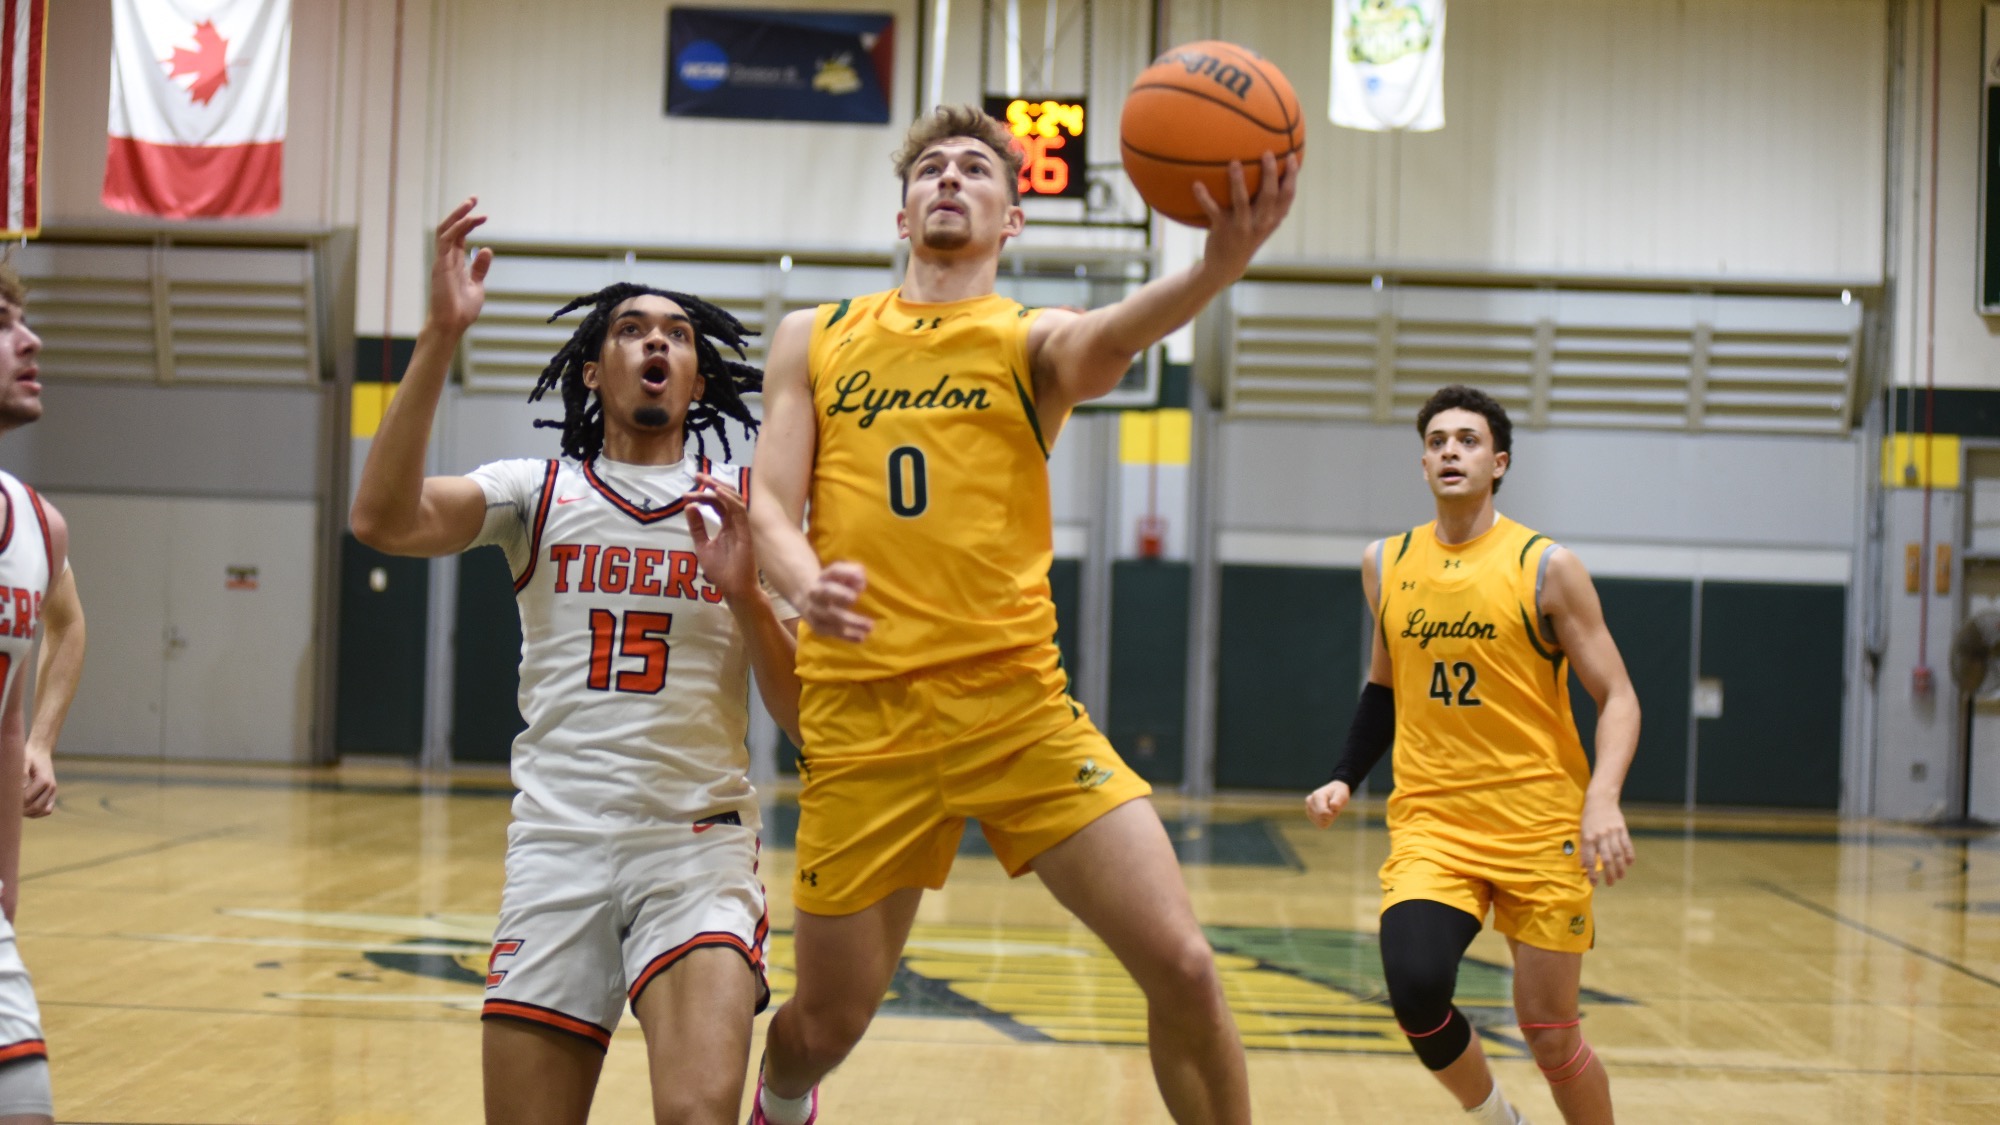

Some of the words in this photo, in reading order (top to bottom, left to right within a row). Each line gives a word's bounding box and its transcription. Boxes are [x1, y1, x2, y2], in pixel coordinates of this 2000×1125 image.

[1006, 100, 1084, 138] 5:24
[826, 370, 992, 429] Lyndon
[887, 445, 928, 519] 0
[587, 608, 673, 695] 15
[1401, 608, 1498, 650] Lyndon
[1429, 660, 1483, 707] 42
